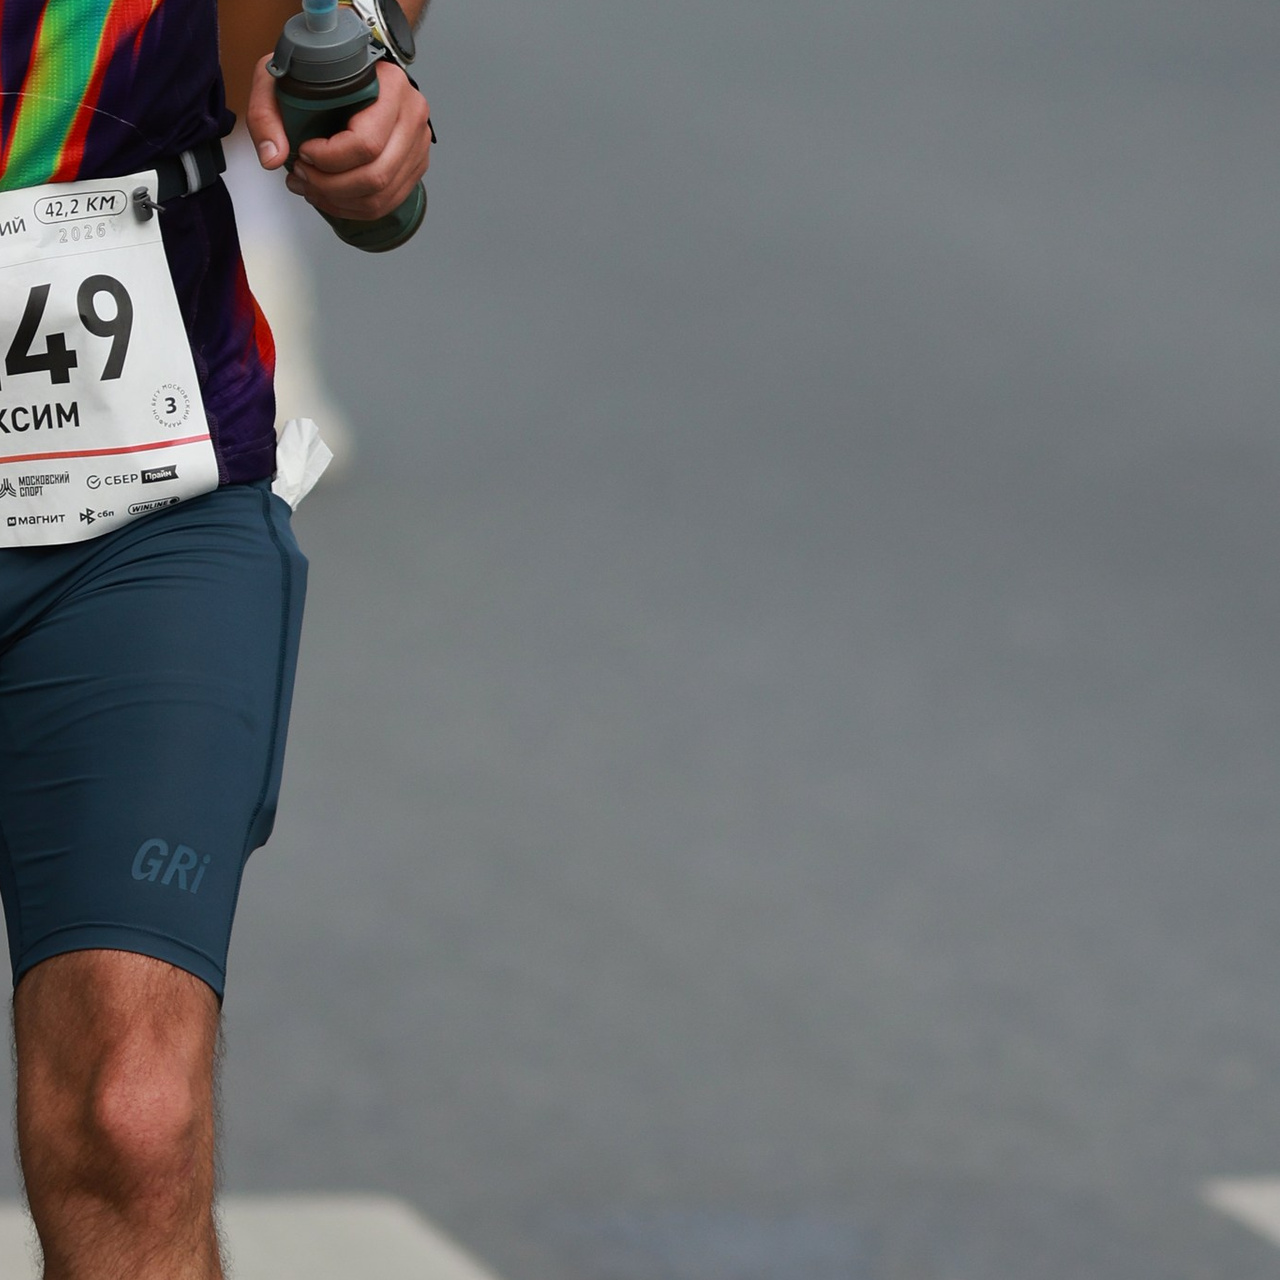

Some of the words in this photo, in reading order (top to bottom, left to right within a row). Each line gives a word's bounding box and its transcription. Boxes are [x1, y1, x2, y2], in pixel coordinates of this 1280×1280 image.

[44, 199, 79, 218] 42,2
[58, 222, 107, 243] 2026
[164, 396, 177, 414] 3
[18, 471, 70, 486] МОСКОВСКИЙ
[104, 473, 139, 486] СБЕР
[144, 469, 172, 481] Прайм
[19, 486, 43, 498] СПОРТ
[131, 500, 169, 513] WINLINE
